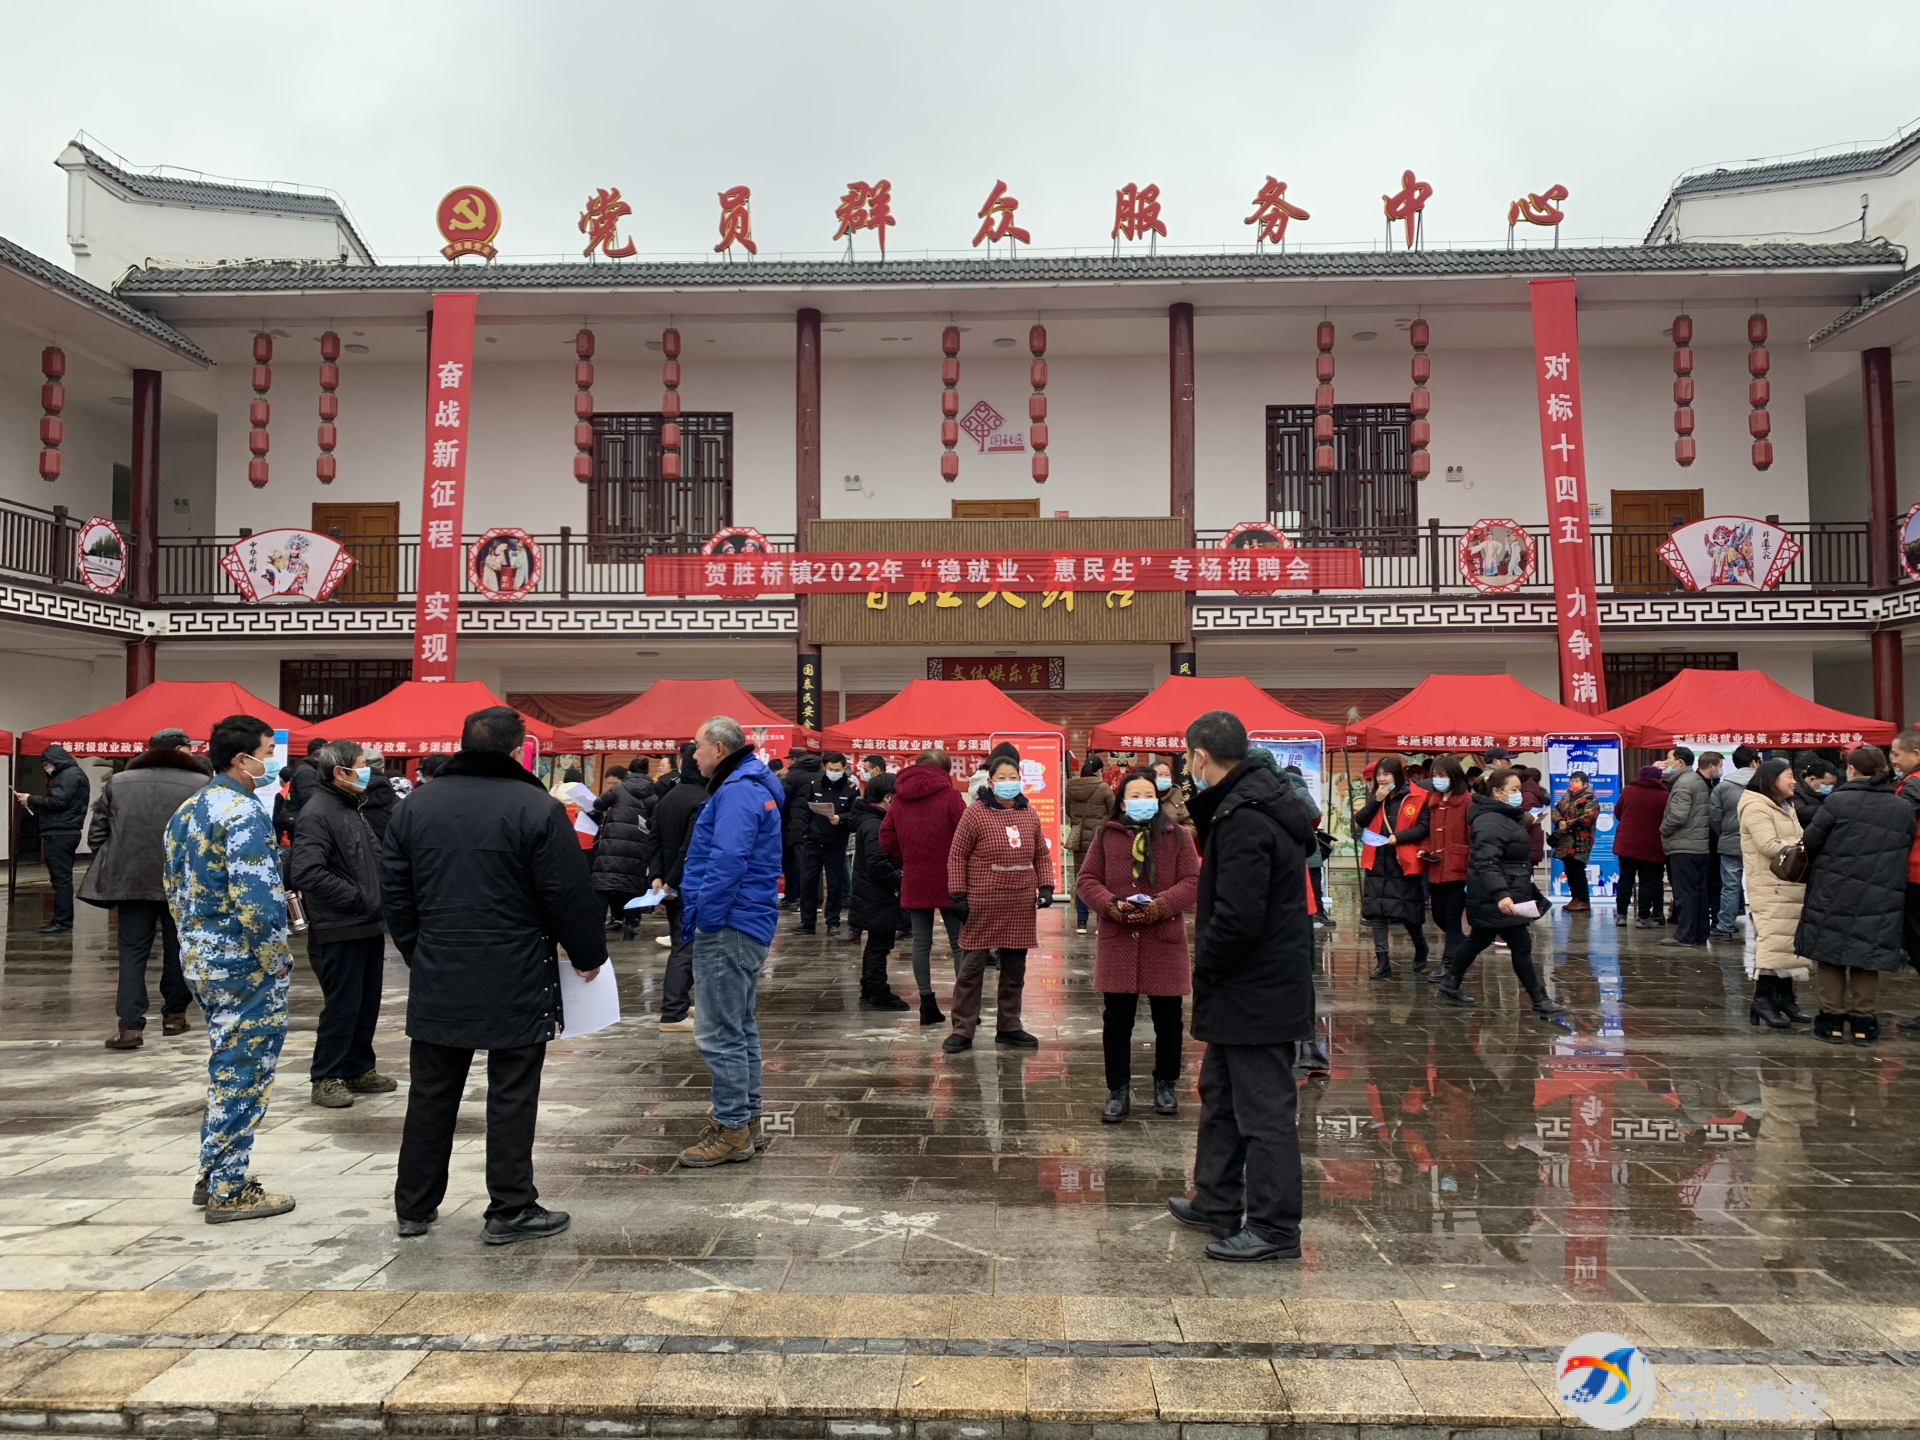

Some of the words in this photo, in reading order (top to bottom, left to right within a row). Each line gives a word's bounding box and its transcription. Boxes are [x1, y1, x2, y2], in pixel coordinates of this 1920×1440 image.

[578, 169, 1569, 259] 党员群众服务中心
[427, 361, 464, 549] 奋战新征程
[1543, 352, 1583, 545] 对标十四五
[1566, 587, 1598, 704] 力争满
[421, 591, 450, 681] 实现
[951, 663, 1043, 684] 文体娱乐室
[1566, 761, 1598, 777] 招聘
